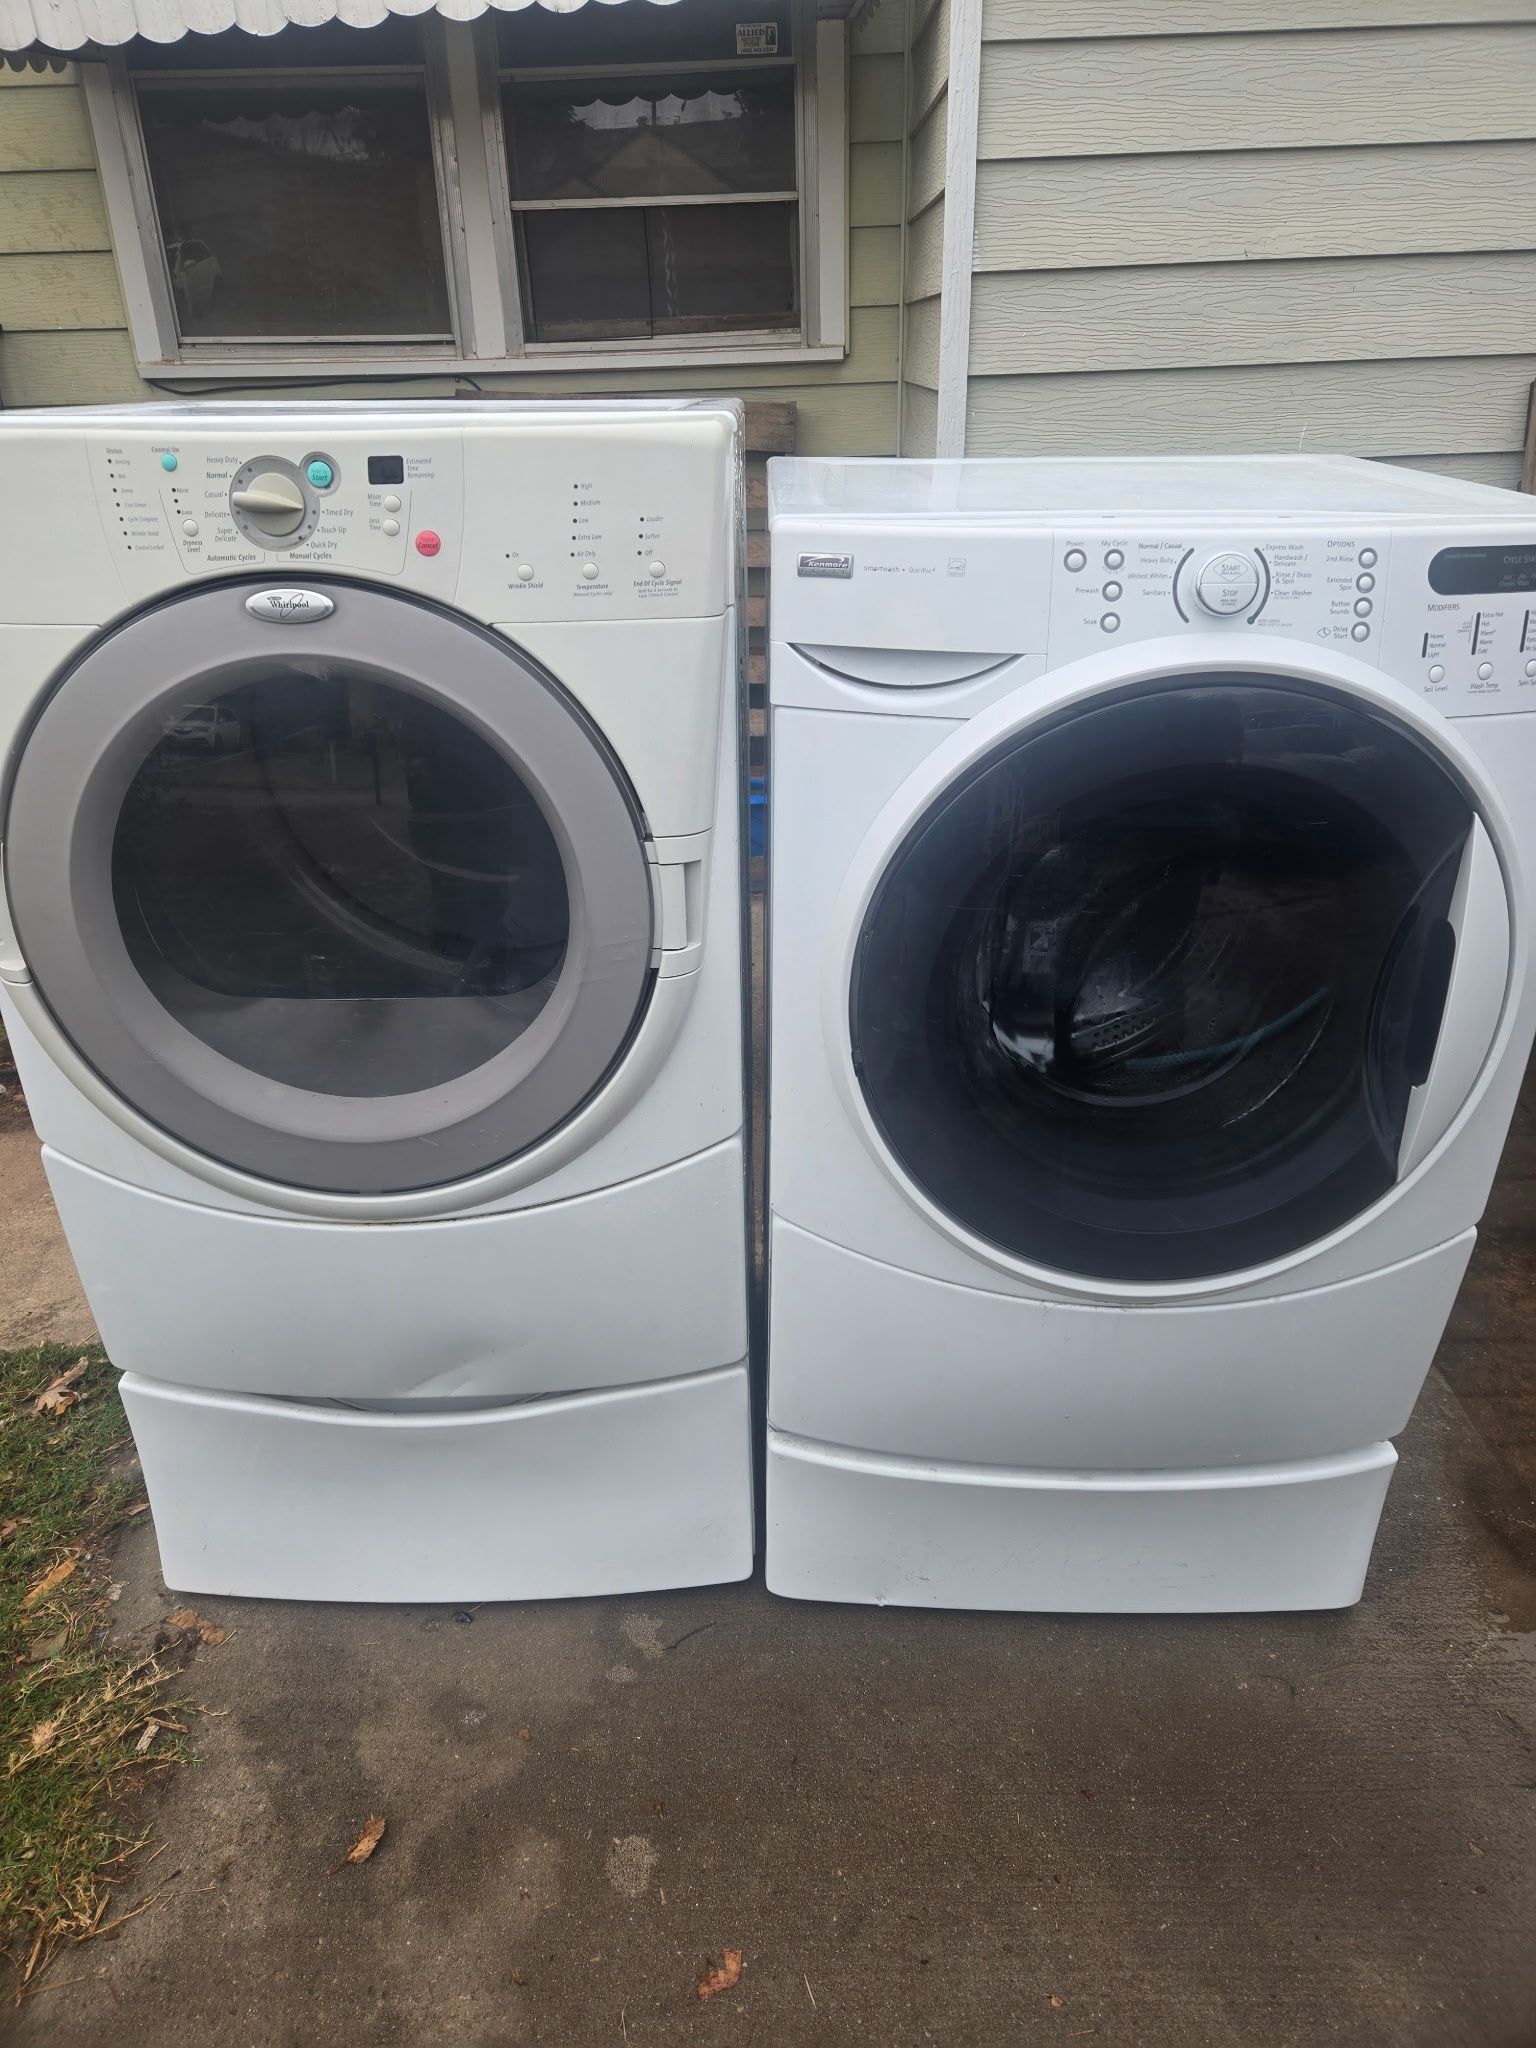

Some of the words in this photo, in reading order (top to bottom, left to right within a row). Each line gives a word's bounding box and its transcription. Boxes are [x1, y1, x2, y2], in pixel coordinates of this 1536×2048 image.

[738, 28, 765, 37] ALLIED
[206, 456, 224, 464] Heavy
[225, 456, 239, 464] Duty
[206, 471, 228, 479] Normal
[204, 490, 224, 498] Casual
[343, 508, 354, 517] Dry
[217, 527, 233, 535] Super
[320, 526, 337, 534] Touch
[338, 526, 347, 534] Up
[215, 535, 237, 543] Delicate
[310, 541, 327, 549] Quick
[327, 541, 338, 549] Dry
[1102, 540, 1111, 548] My
[1265, 544, 1287, 552] Express
[1327, 540, 1356, 548] OPTIONS
[206, 554, 237, 562] Automatic
[238, 553, 257, 562] Cycles
[289, 552, 312, 560] Manual
[313, 551, 332, 560] Cycles
[1523, 554, 1536, 563] STA
[808, 560, 848, 568] Kenmore
[1221, 564, 1241, 572] START
[665, 578, 683, 586] Signal
[1282, 577, 1295, 585] Spin
[1326, 576, 1353, 584] Extended
[576, 583, 609, 591] Temperature
[1222, 589, 1239, 597] STOP
[270, 600, 310, 610] Whirlpool
[1427, 603, 1461, 612] MODIFIERS
[1333, 625, 1349, 633] Delay
[1427, 651, 1440, 659] Light
[1424, 685, 1434, 693] Soil
[1470, 682, 1485, 690] Wash
[1486, 682, 1499, 690] Temp
